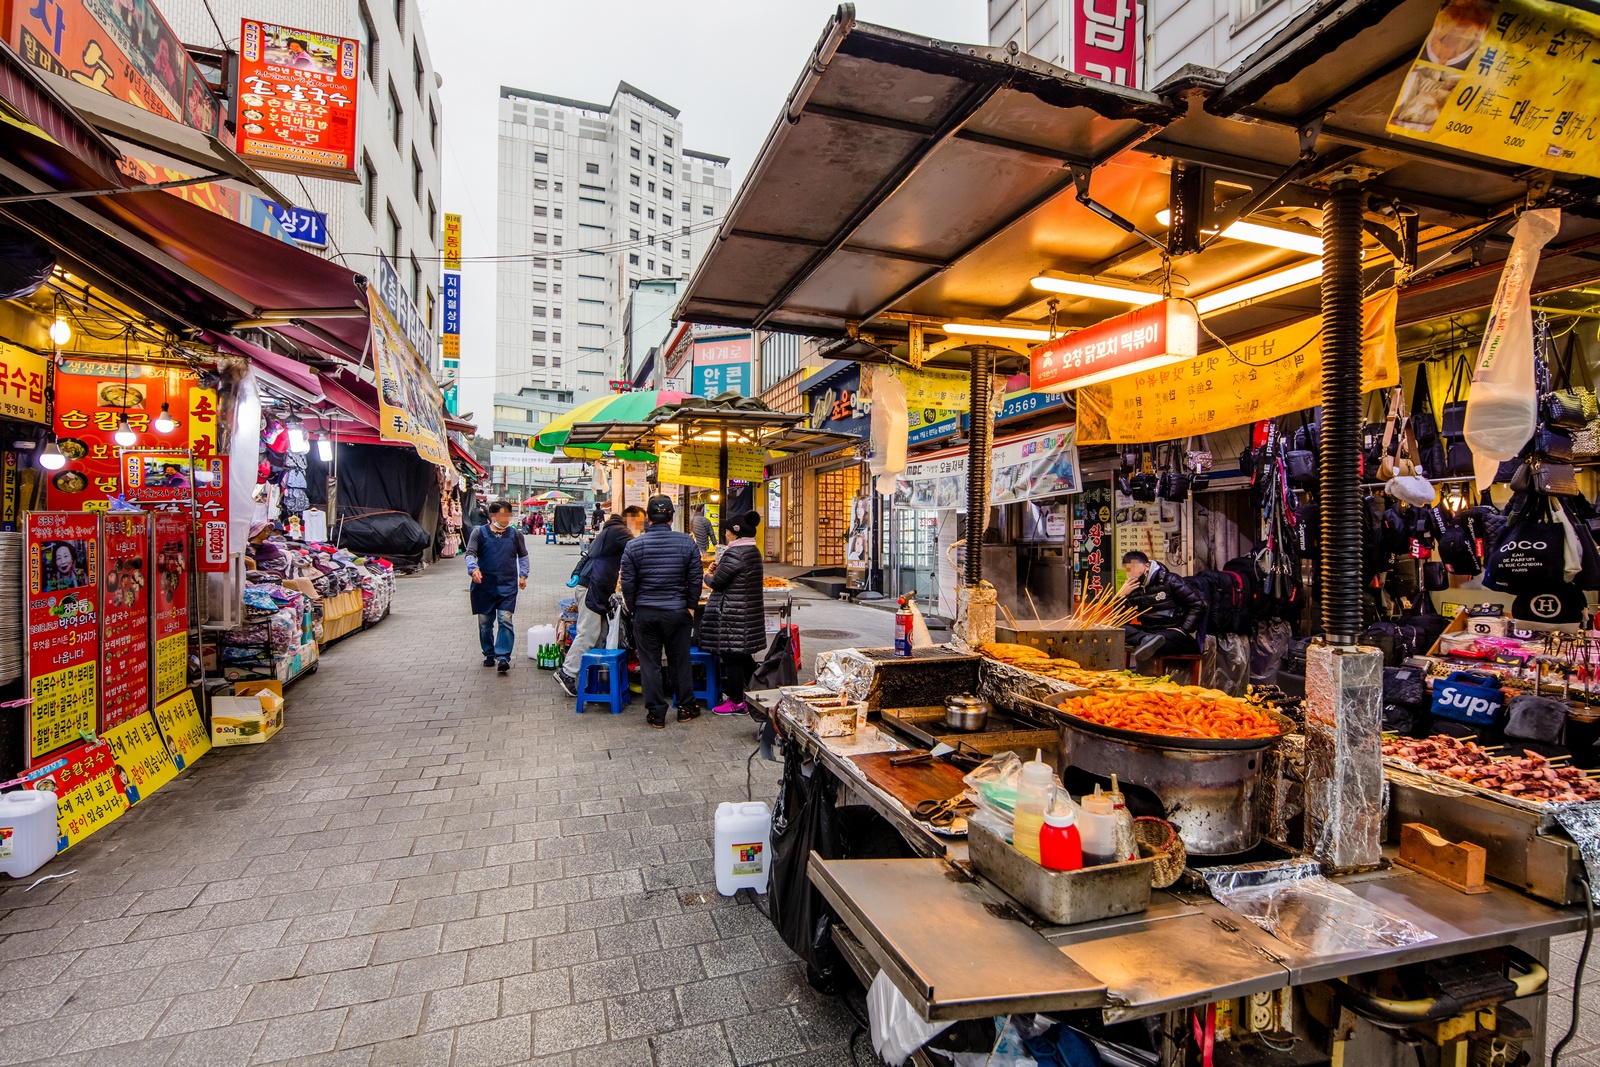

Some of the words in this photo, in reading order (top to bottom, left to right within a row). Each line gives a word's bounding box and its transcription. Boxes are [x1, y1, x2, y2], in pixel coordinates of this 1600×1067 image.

[245, 23, 259, 61] 착한가격
[267, 65, 290, 75] 50년
[294, 69, 322, 80] 전통의
[1456, 11, 1519, 113] 떡볶이
[244, 76, 352, 108] 손칼국수
[1445, 120, 1473, 135] 3,000
[1503, 135, 1526, 148] 3,000
[446, 223, 459, 261] 부동산
[447, 277, 457, 332] 지하철상가
[702, 345, 742, 361] 세계로
[1062, 346, 1083, 370] 오창
[1085, 335, 1118, 365] 닭꼬치
[1120, 322, 1159, 352] 떡볶이
[5, 402, 25, 415] 방영의
[60, 409, 182, 433] 손칼국
[994, 397, 1036, 418] -2569
[906, 464, 922, 475] MBC
[939, 459, 964, 474] 오늘저녁
[5, 452, 15, 520] 손칼국수
[38, 515, 54, 526] SBS
[1298, 523, 1307, 551] Supreme
[1500, 540, 1547, 553] COCO
[31, 546, 39, 591] 착한가격
[1088, 523, 1104, 599] 왕만두
[31, 599, 47, 609] KBS
[105, 610, 129, 625] 손칼국수
[1537, 599, 1555, 612] H
[32, 638, 51, 651] 무엇을
[52, 648, 84, 664] 나옵니다
[36, 676, 56, 697] 칼국수
[77, 663, 95, 682] 보리밥
[36, 700, 56, 721] 보리밥
[60, 693, 78, 713] 칼국수
[159, 711, 173, 732] 안에
[173, 705, 186, 720] 자리
[185, 698, 197, 717] 넓고
[1437, 687, 1500, 717] Supr
[36, 725, 50, 747] 찰밥
[53, 717, 72, 740] 칼국수
[126, 729, 143, 752] 자리
[141, 721, 157, 745] 넓고
[177, 735, 192, 754] 많이
[186, 723, 208, 748] 있습니다
[60, 751, 106, 782] 손칼국수
[131, 761, 149, 786] 많이
[143, 748, 170, 777] 있습니다
[75, 788, 95, 807] 자리
[95, 778, 114, 797] 넓고
[68, 813, 89, 835] 많이
[86, 795, 120, 825] 있습니다
